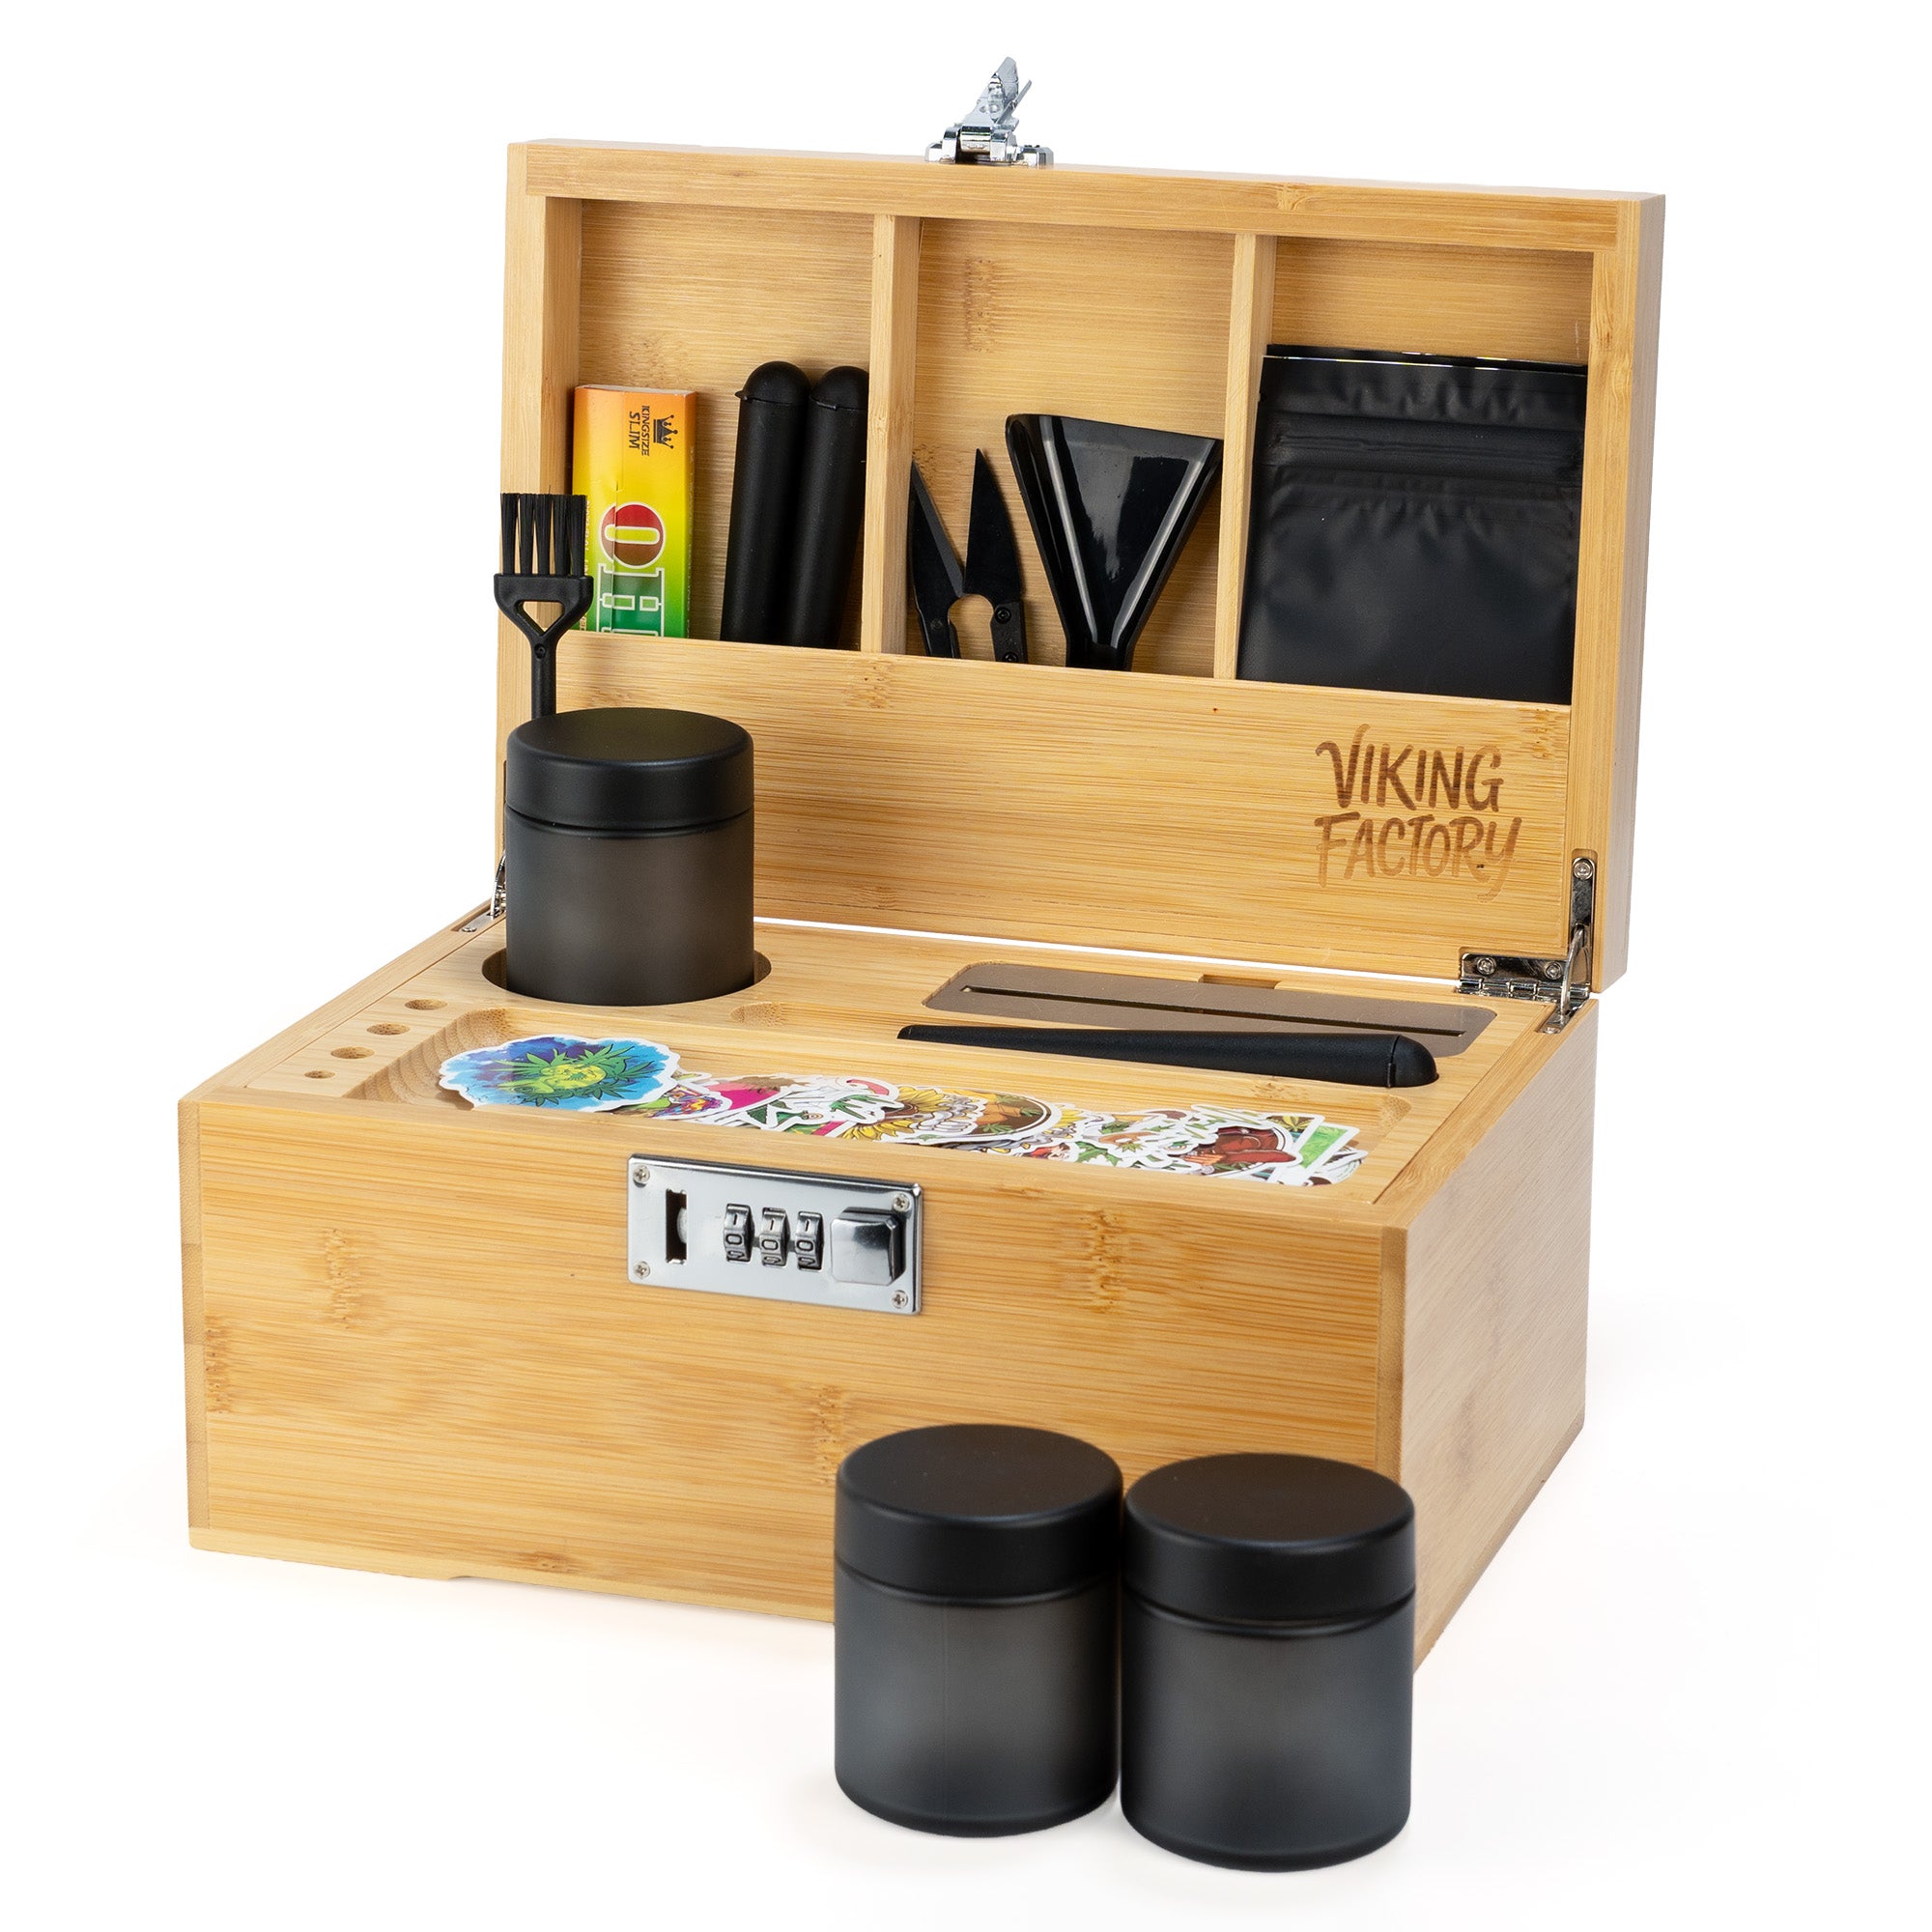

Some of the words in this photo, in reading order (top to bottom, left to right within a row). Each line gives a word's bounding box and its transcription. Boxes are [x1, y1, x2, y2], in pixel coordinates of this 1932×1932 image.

[629, 411, 640, 450] SLIM
[641, 405, 650, 457] KINGSIZE
[1315, 724, 1504, 812] VIKING
[1314, 811, 1522, 903] FACTORY
